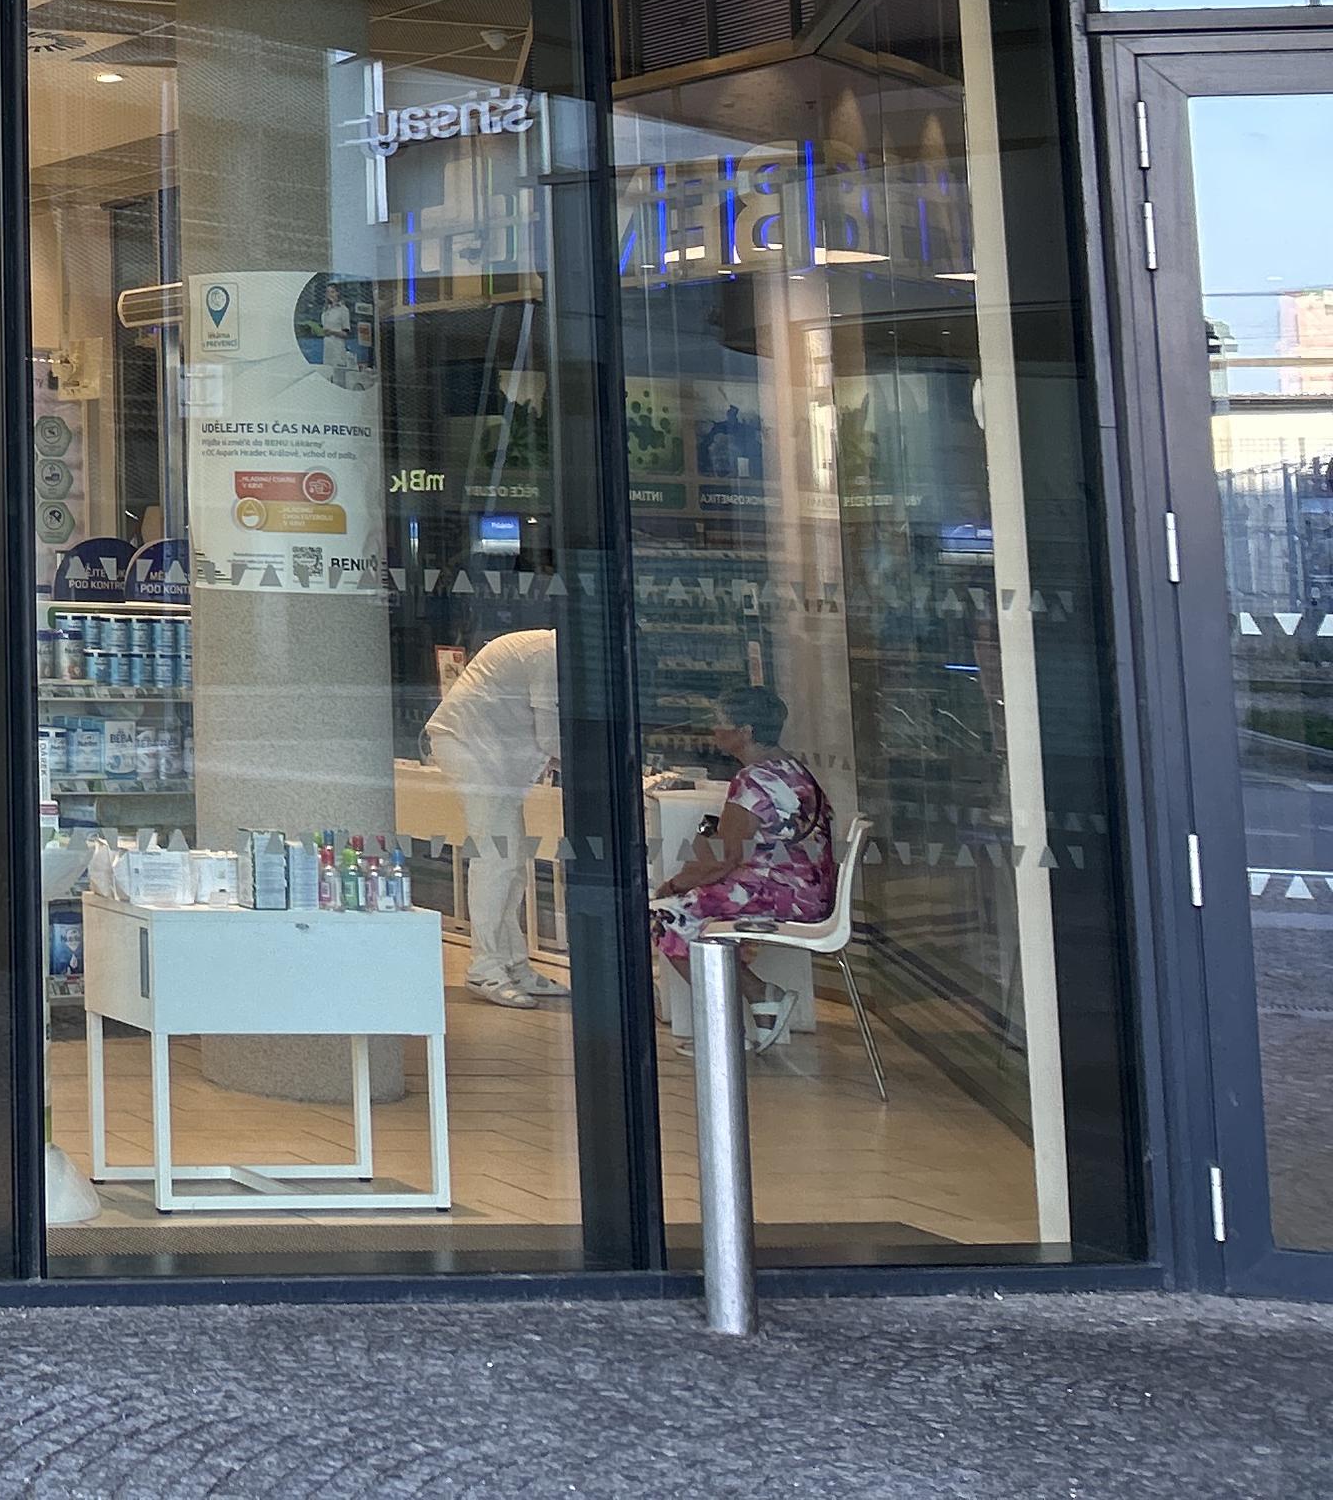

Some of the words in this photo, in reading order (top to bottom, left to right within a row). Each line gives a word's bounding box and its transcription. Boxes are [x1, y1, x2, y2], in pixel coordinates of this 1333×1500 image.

[202, 420, 253, 434] UDĚLEJTE
[257, 423, 268, 433] SI
[274, 421, 298, 434] ČAS
[302, 423, 320, 434] NA
[68, 580, 89, 589] POD
[140, 584, 161, 594] POD
